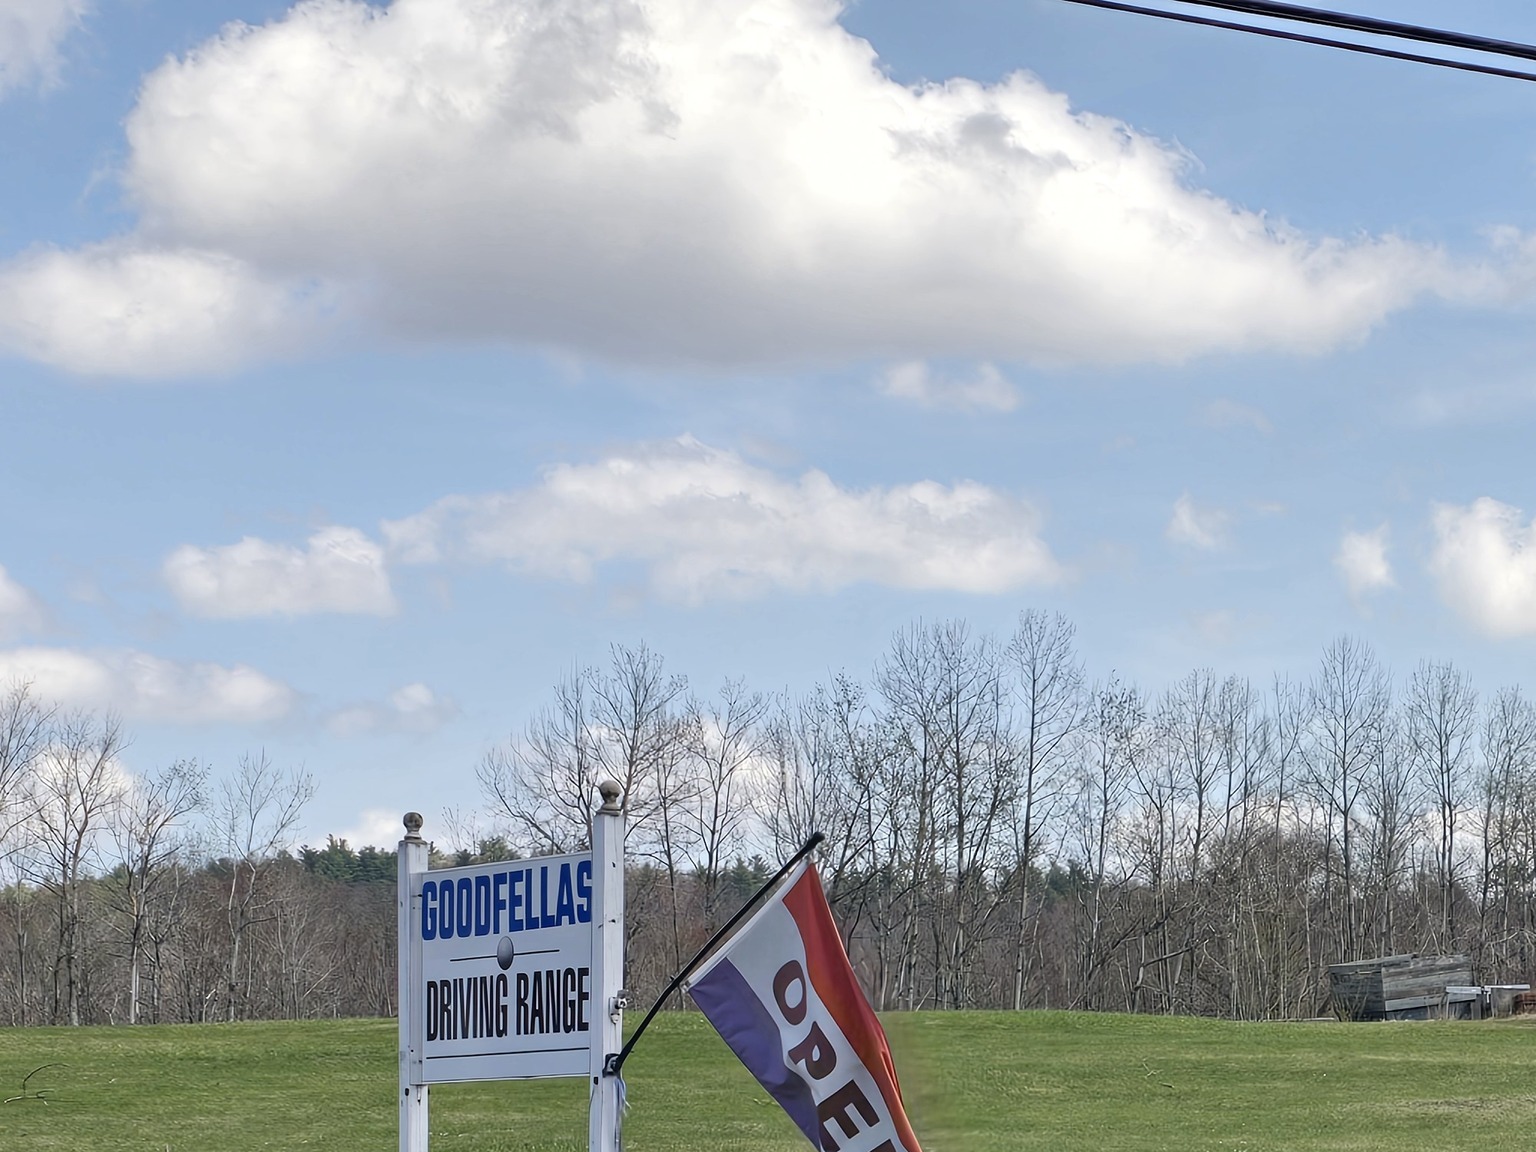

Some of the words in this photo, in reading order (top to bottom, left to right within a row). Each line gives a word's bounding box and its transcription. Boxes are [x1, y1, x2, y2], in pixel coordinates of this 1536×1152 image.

[421, 860, 593, 941] GOODFELLAS
[426, 973, 508, 1042] DRIVING
[516, 967, 589, 1036] RANGE
